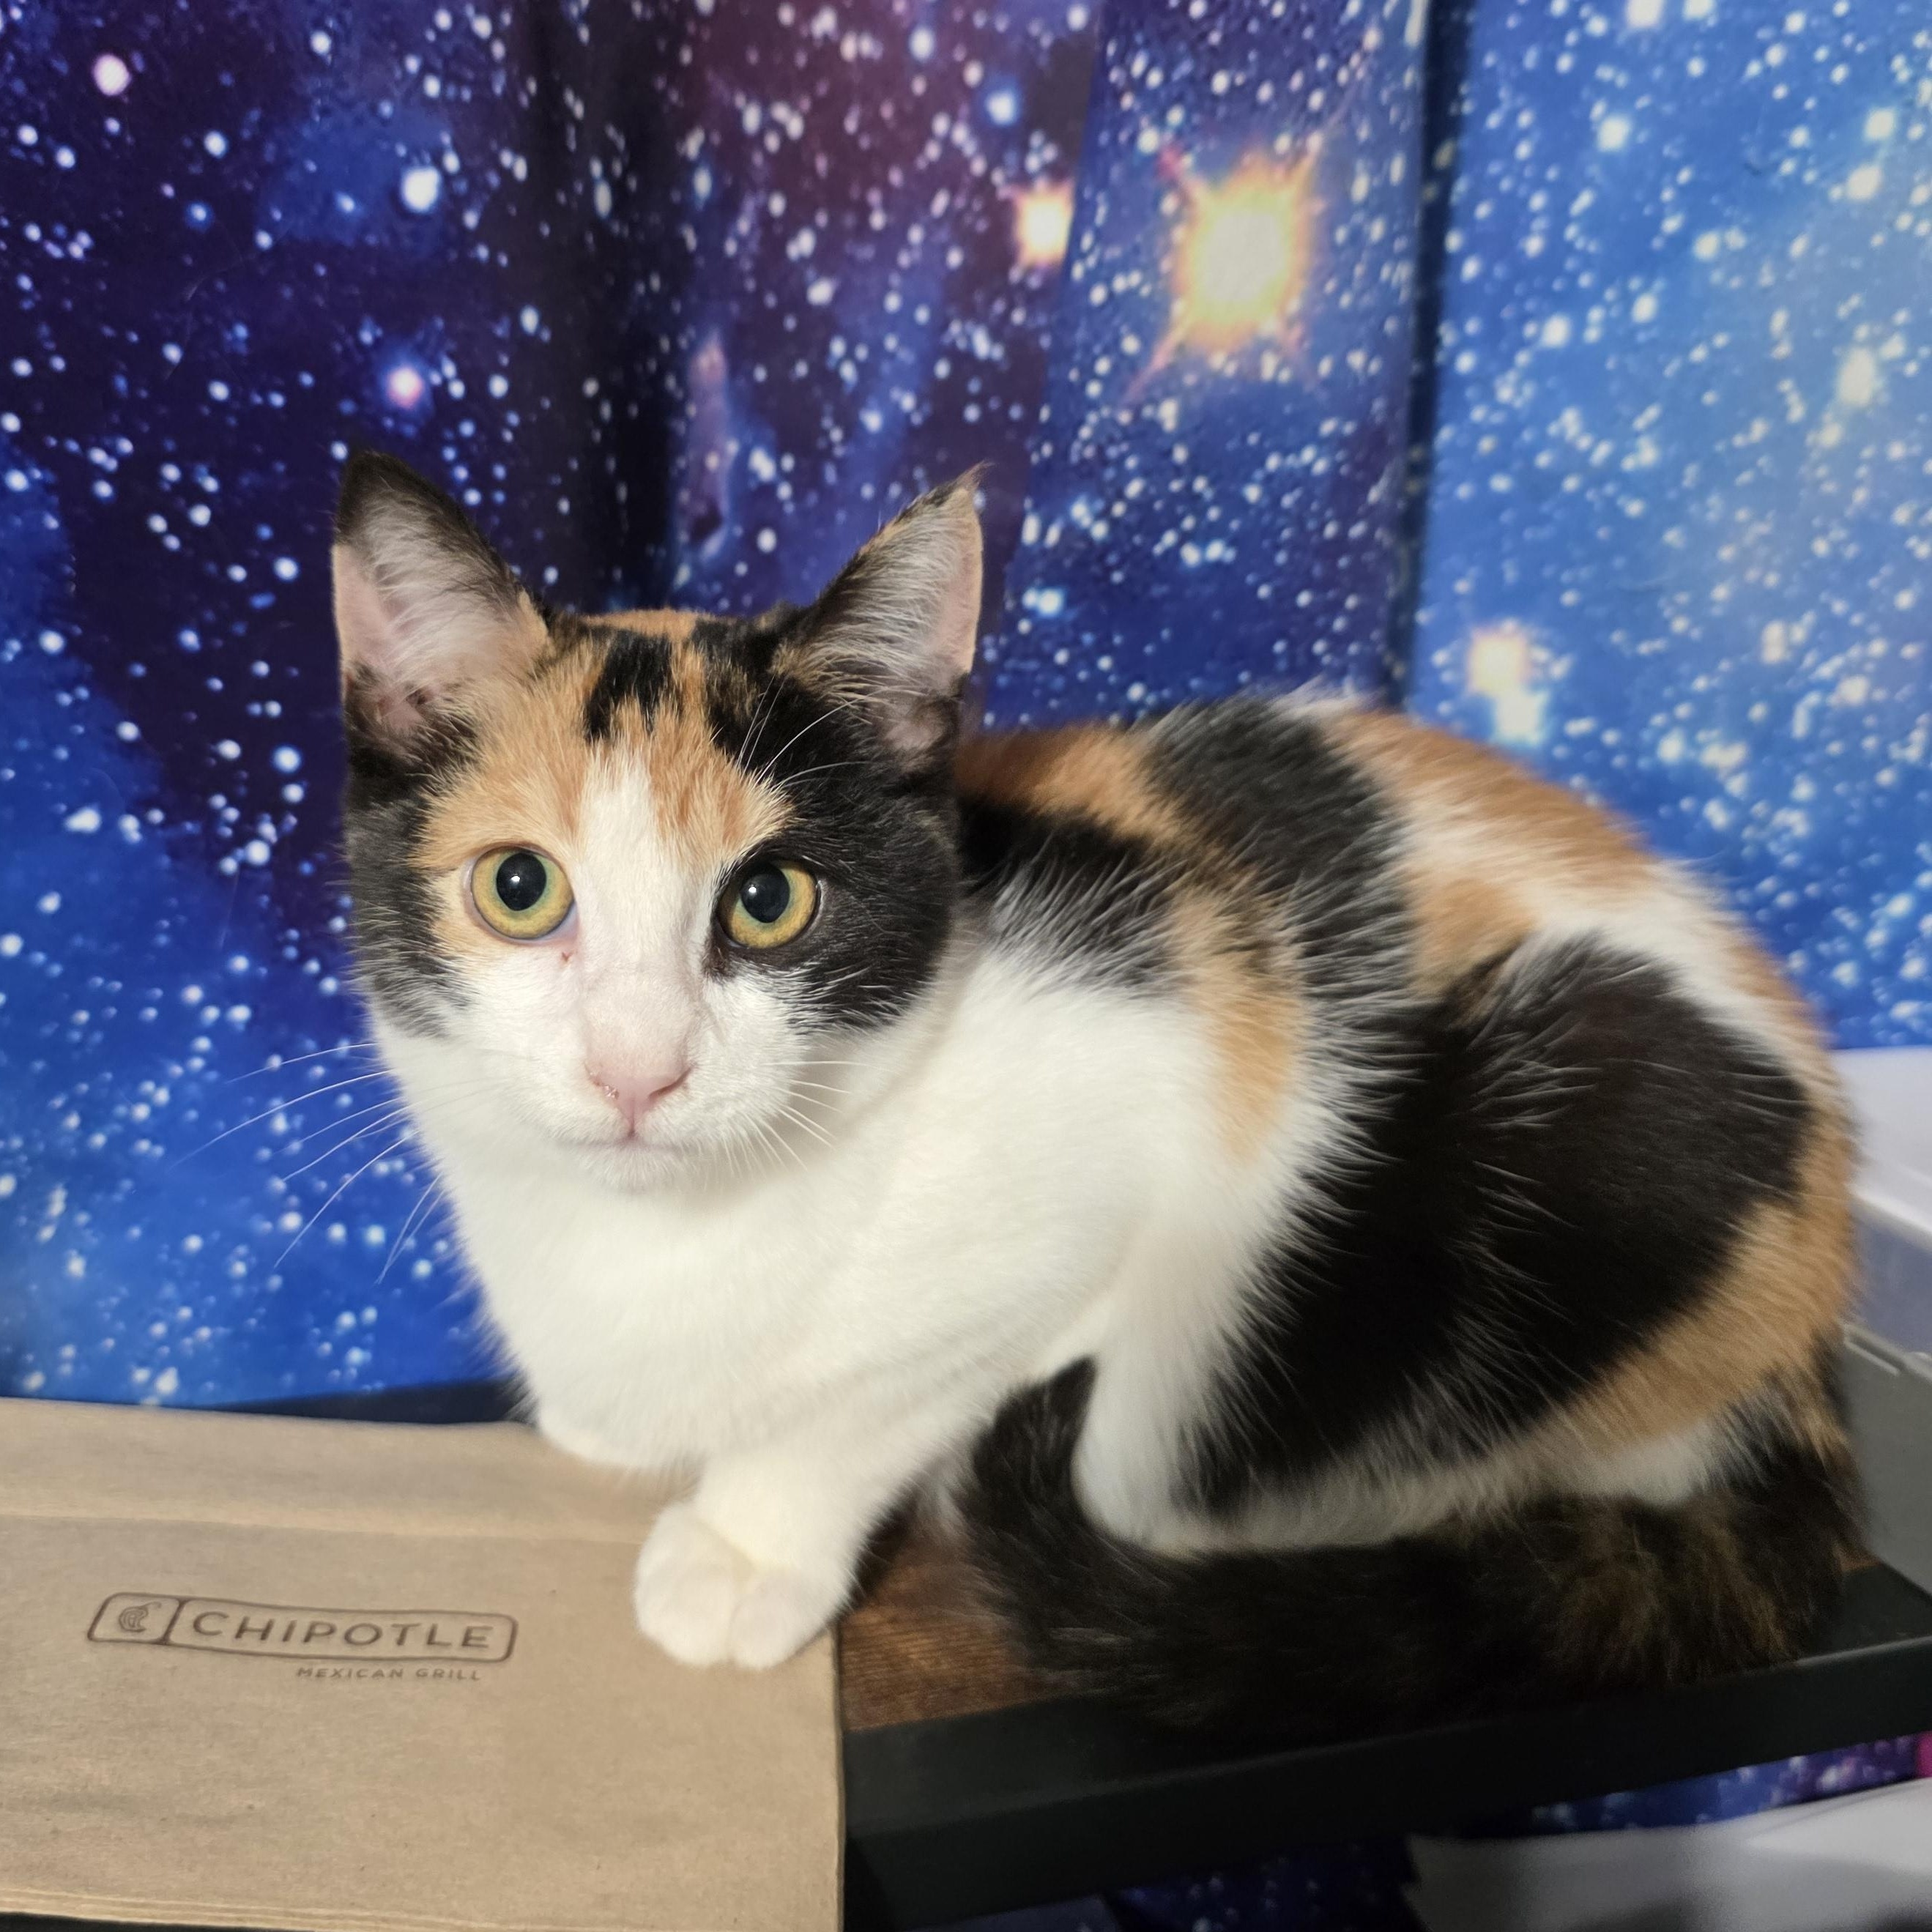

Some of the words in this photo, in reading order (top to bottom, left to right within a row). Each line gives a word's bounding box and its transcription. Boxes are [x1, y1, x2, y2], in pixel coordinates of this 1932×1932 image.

[192, 1610, 494, 1649] CHIPOTLE
[296, 1666, 404, 1680] MEXICAN
[415, 1668, 481, 1682] GRILL
